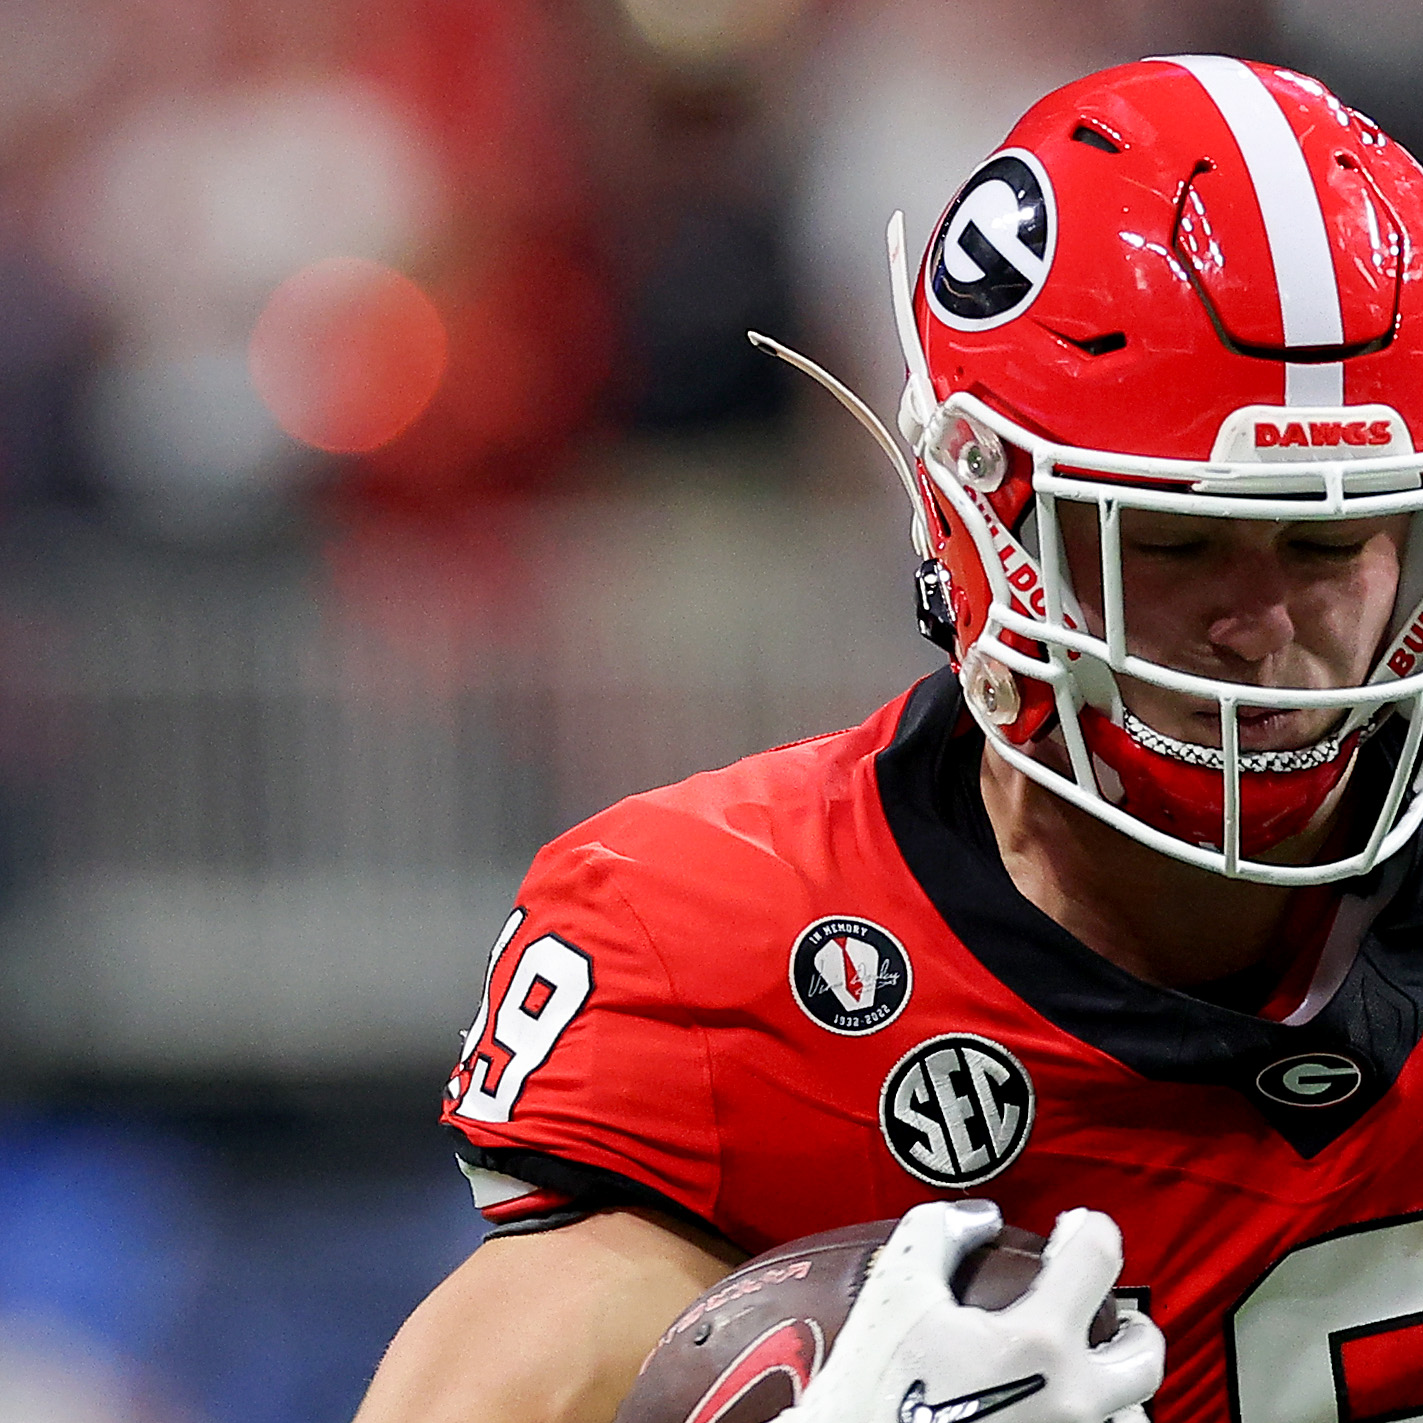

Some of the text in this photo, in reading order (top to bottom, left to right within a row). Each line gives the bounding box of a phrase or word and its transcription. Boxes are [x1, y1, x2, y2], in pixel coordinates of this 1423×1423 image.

[1255, 421, 1392, 447] DAWGS
[808, 923, 868, 945] IN MEMORY
[834, 1004, 891, 1027] 1932-2022
[893, 1047, 1020, 1176] SEC
